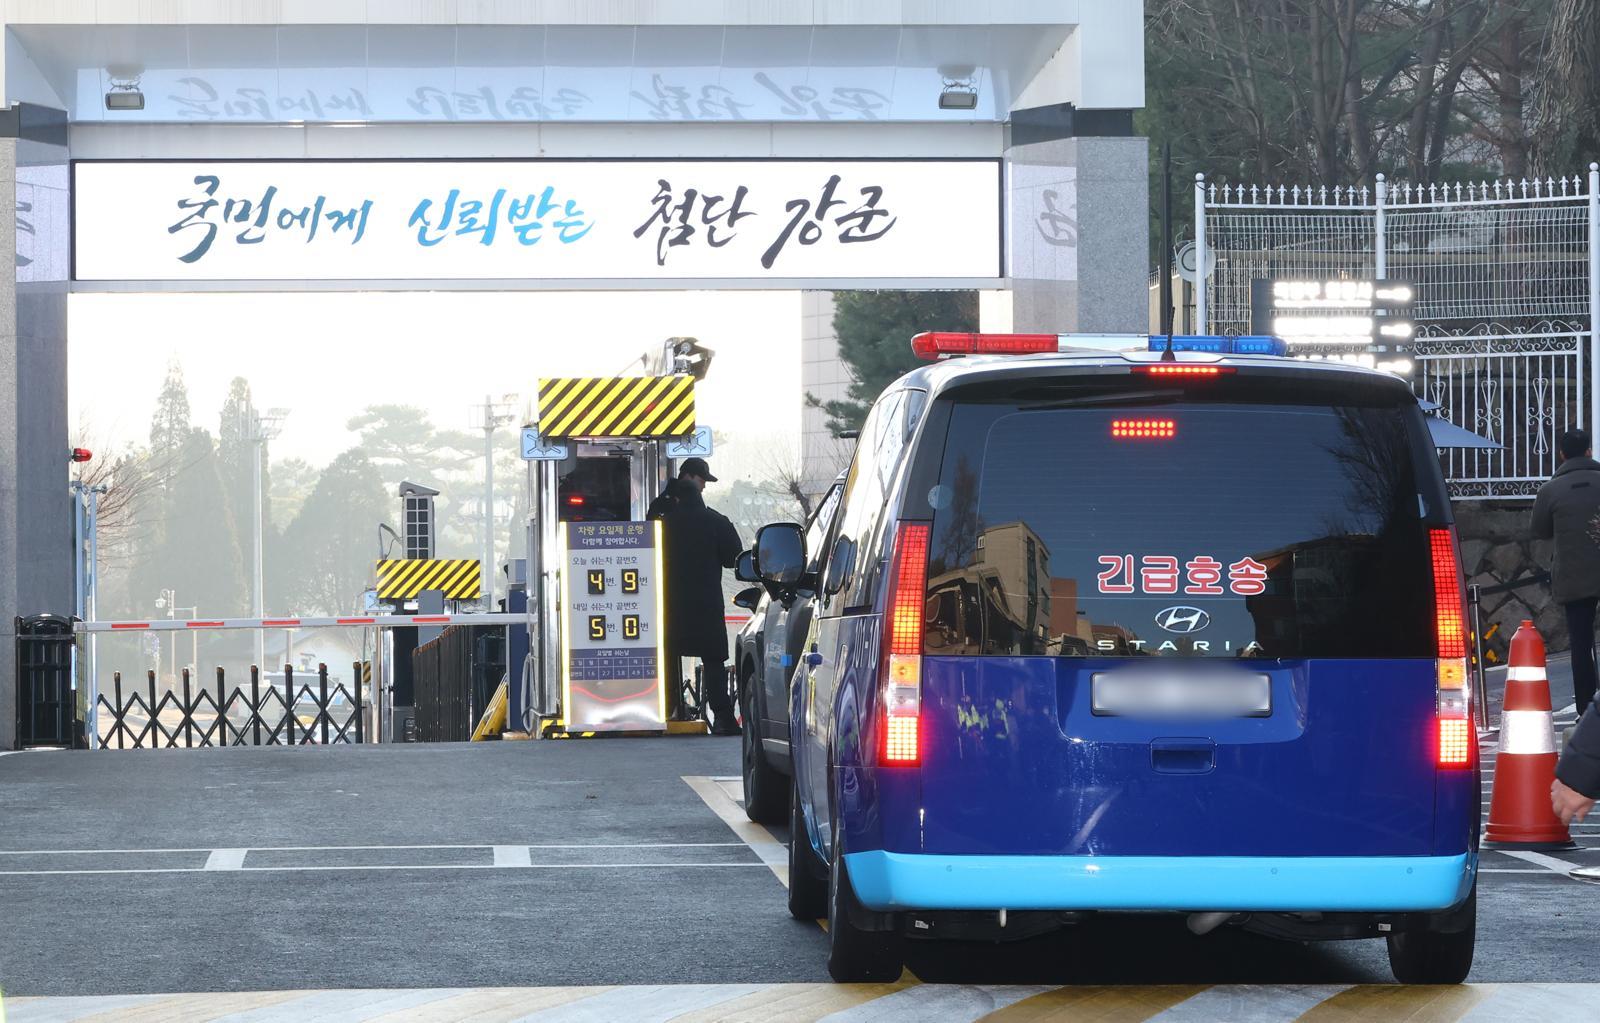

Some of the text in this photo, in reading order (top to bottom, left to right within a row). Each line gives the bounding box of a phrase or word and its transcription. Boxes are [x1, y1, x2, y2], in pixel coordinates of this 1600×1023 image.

[168, 174, 898, 269] 국민에게 신뢰받는 첨단 강군
[577, 525, 645, 536] 차량 요일제 운행
[582, 538, 603, 546] 다함께
[572, 556, 638, 565] 오늘 쉬는차 끝번호
[1098, 554, 1267, 596] 긴급호송
[573, 602, 638, 611] 내일 쉬는차 끝번호
[1097, 640, 1265, 651] STARIA
